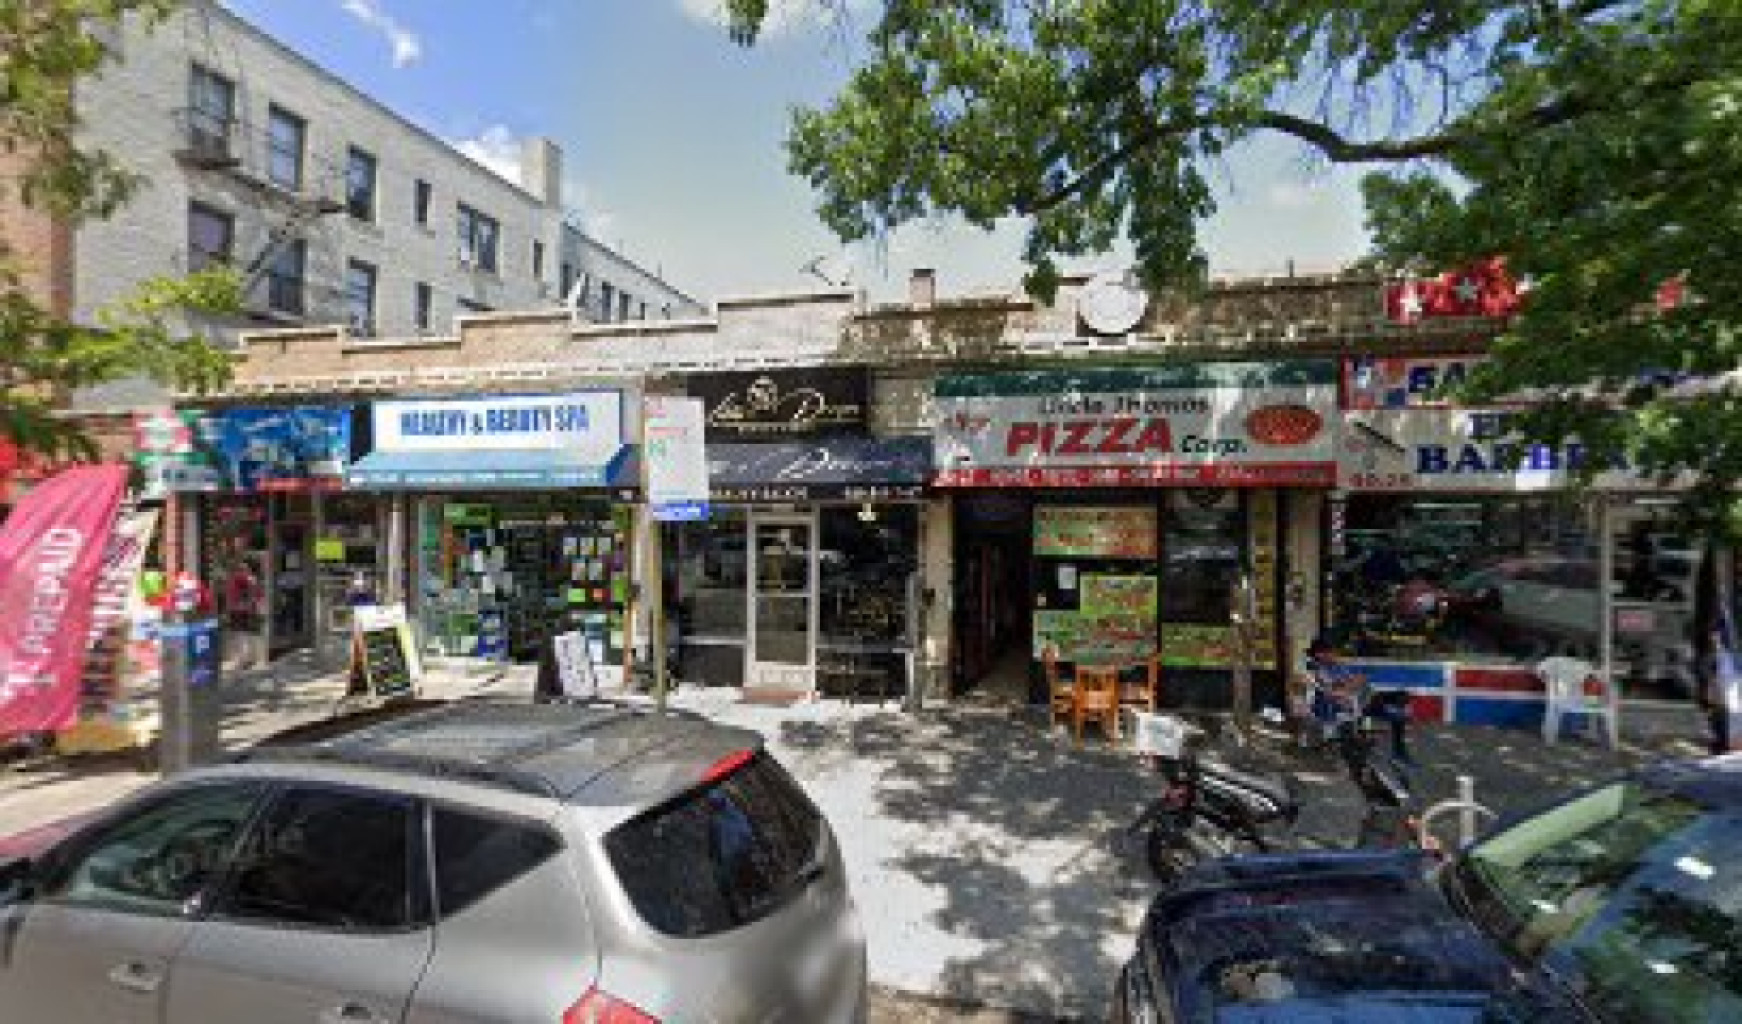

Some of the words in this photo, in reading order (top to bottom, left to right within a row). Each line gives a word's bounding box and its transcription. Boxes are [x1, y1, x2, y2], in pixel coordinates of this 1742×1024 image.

[486, 406, 552, 432] BEAUTY
[554, 404, 590, 431] SPA
[1006, 417, 1174, 456] PIZZA
[1179, 434, 1248, 456] Corp.
[18, 528, 83, 655] PREPAID
